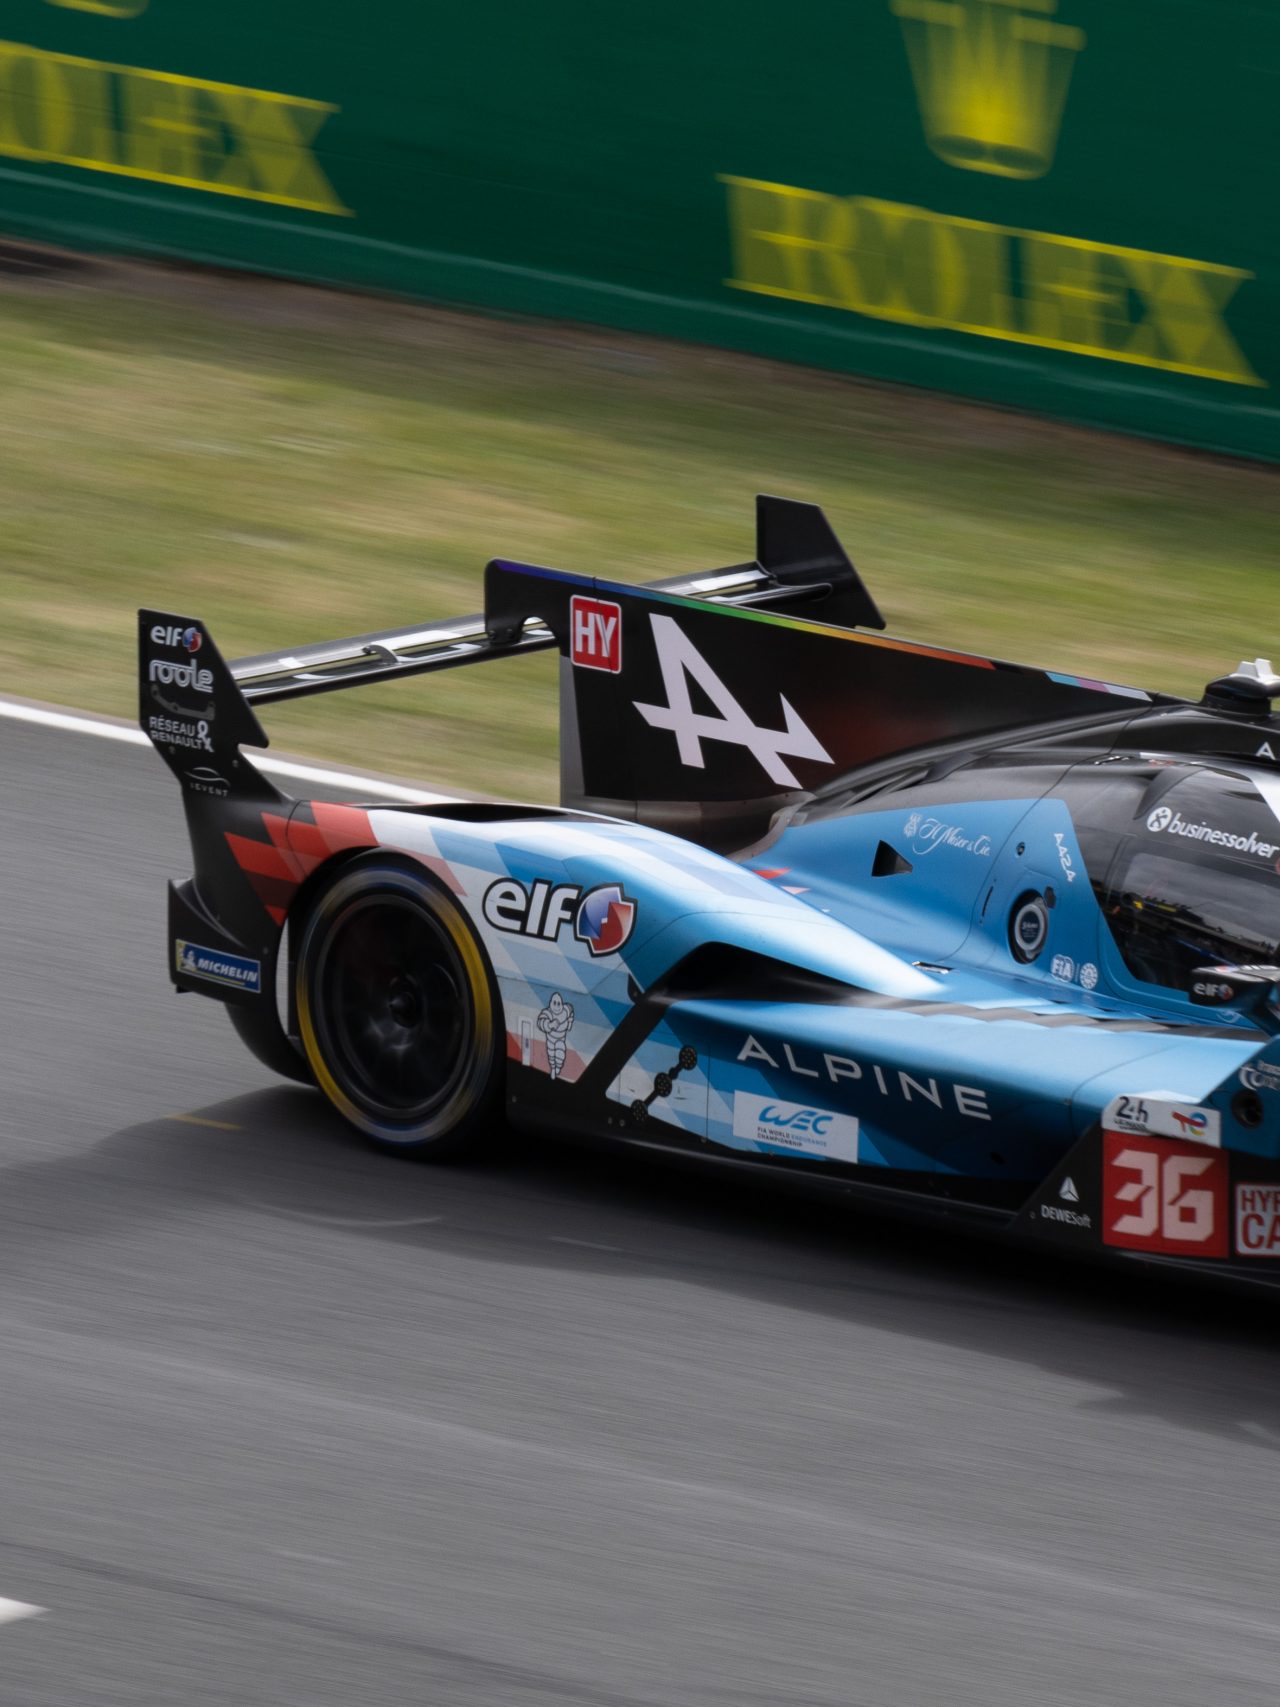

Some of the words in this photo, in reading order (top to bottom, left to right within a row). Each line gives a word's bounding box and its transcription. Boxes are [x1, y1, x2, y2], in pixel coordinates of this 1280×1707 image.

[0, 38, 356, 219] OLEX
[715, 172, 1268, 389] ROLEX
[151, 625, 183, 647] elf
[574, 610, 617, 658] HY
[149, 658, 213, 693] roole
[149, 715, 196, 737] RÉSEAU
[151, 730, 203, 750] RENAULT
[1167, 811, 1280, 859] businessolver
[486, 878, 578, 940] elf
[198, 958, 258, 982] MICHELIN
[737, 1034, 992, 1121] ALPINE
[758, 1105, 833, 1135] WEC
[757, 1132, 803, 1147] CHAMPIONSHIP
[768, 1130, 791, 1139] WORLD
[791, 1134, 828, 1147] ENDURANCE
[1111, 1149, 1215, 1242] 36
